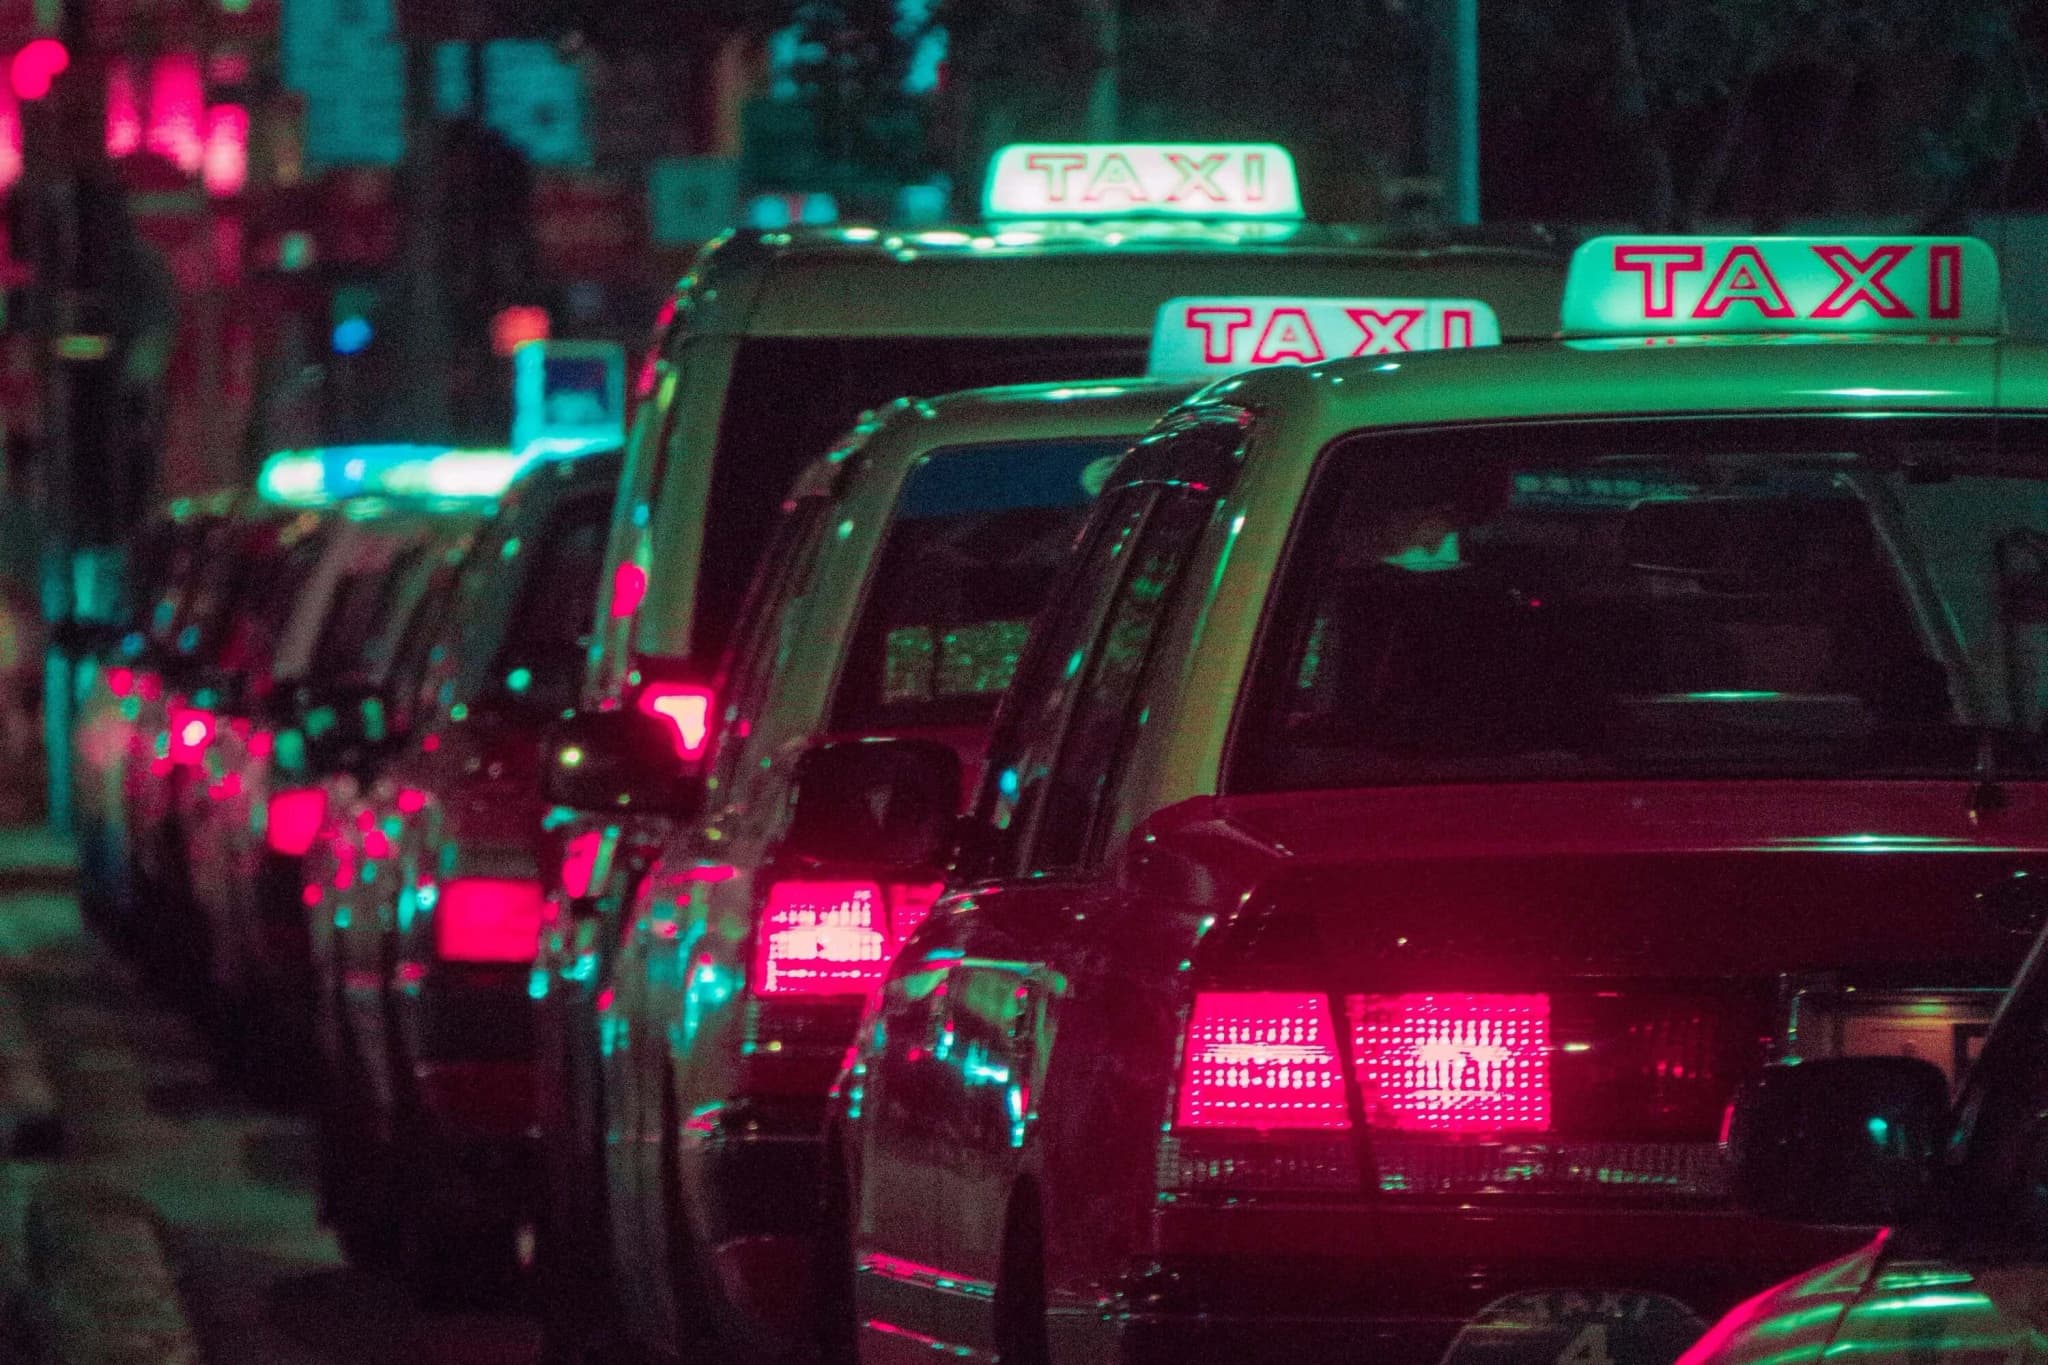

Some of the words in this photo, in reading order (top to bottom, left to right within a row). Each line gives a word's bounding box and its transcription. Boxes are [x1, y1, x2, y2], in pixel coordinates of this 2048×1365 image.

[1026, 153, 1266, 202] TAXI
[1614, 245, 1961, 319] TAXI
[1186, 307, 1473, 364] TAXI
